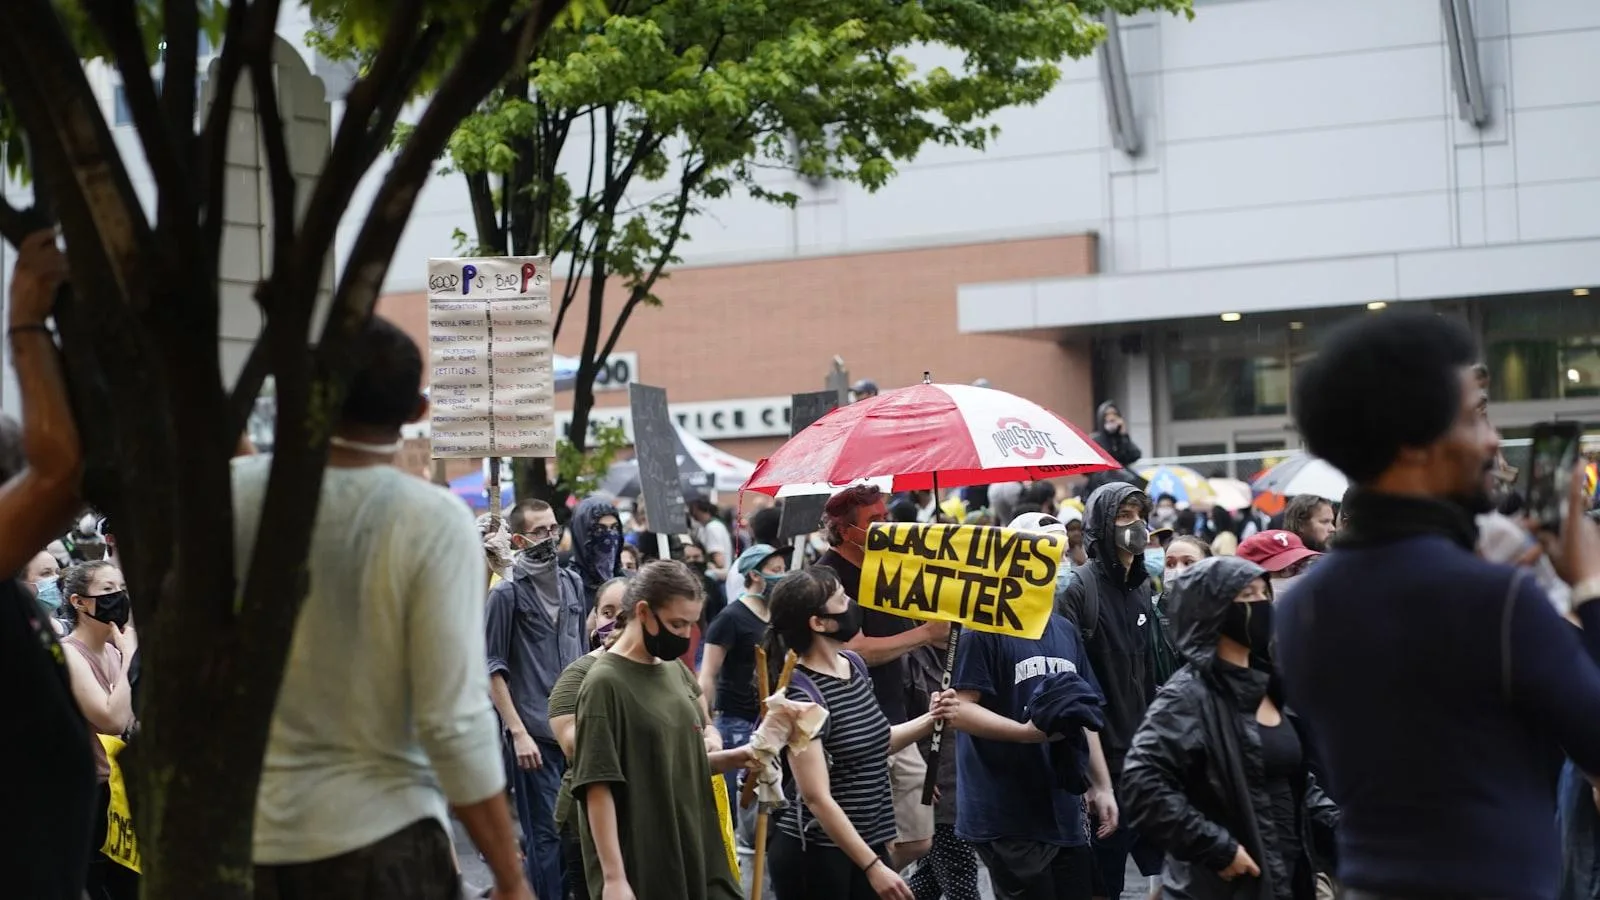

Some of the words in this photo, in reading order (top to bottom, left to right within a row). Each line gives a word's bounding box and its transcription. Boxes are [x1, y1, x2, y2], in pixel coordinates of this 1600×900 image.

[429, 274, 459, 290] GOOD
[495, 274, 518, 287] BAD
[675, 408, 744, 430] TICE
[868, 524, 959, 561] BLACK
[966, 527, 1057, 586] LIVES
[874, 557, 1024, 630] MATTER
